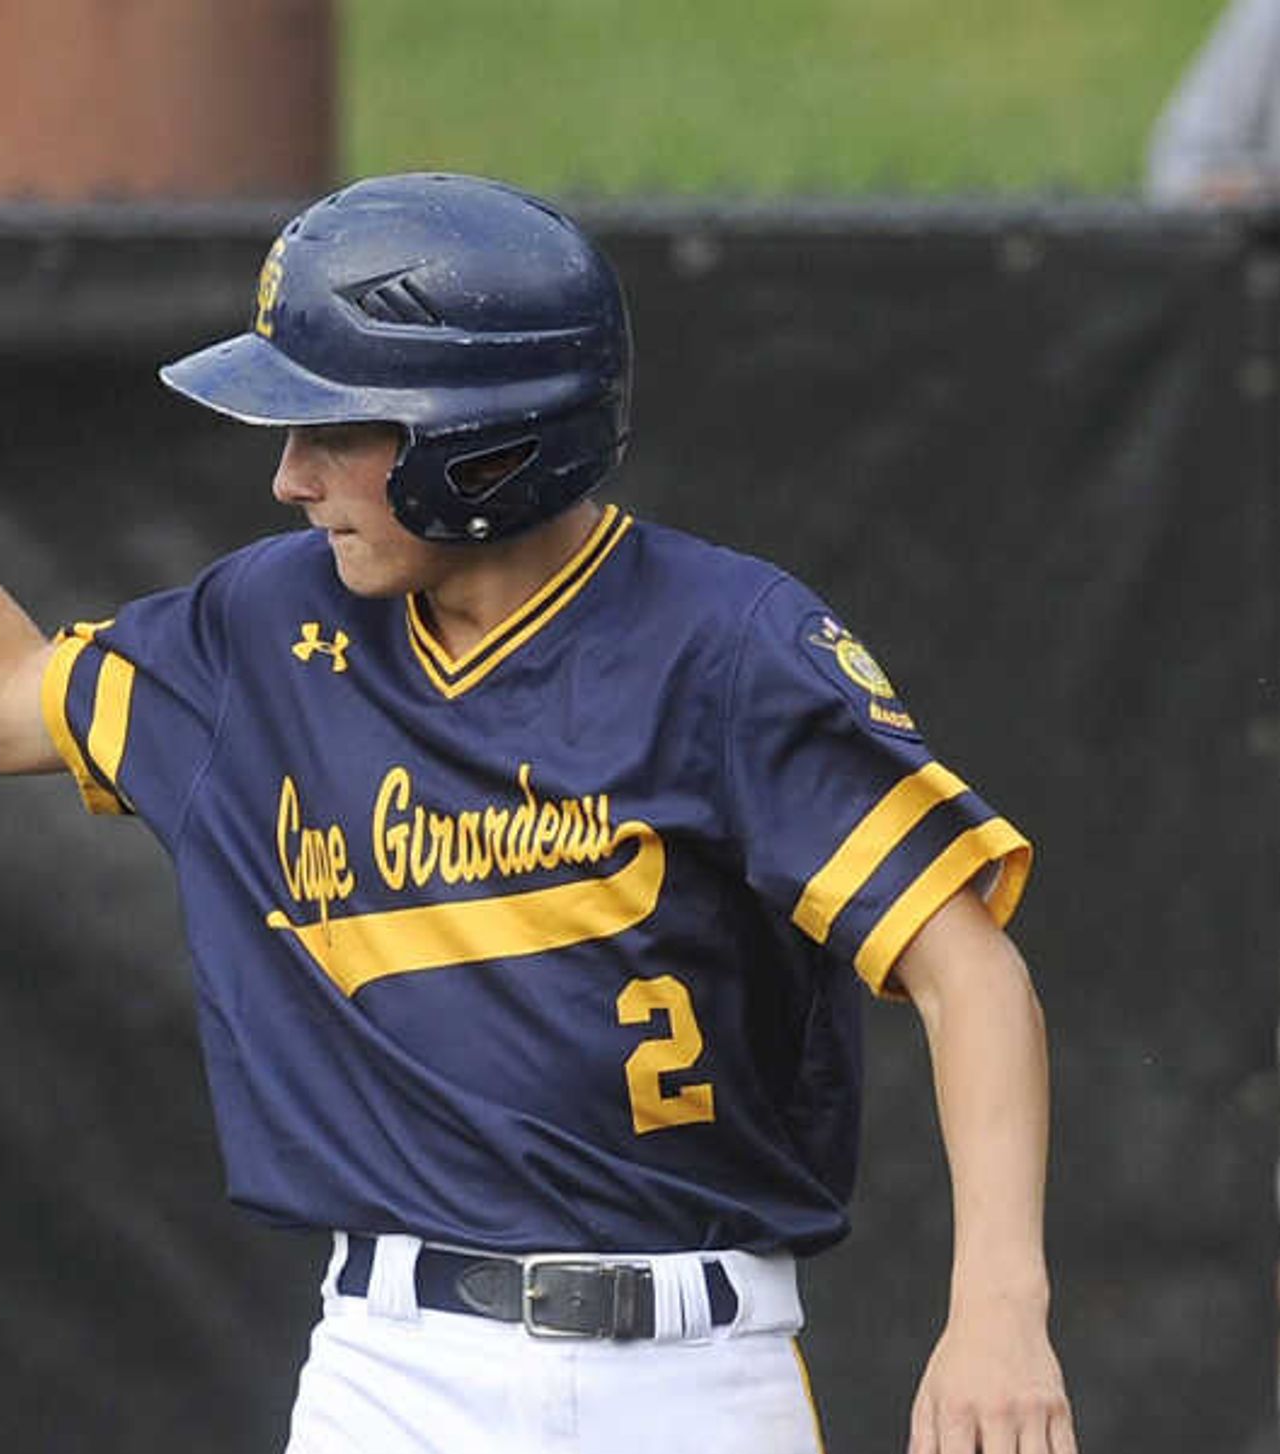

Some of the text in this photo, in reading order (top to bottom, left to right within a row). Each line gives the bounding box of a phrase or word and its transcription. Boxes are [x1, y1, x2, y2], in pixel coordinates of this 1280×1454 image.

[276, 764, 614, 948] Cape Girardeau
[616, 975, 715, 1134] 2
